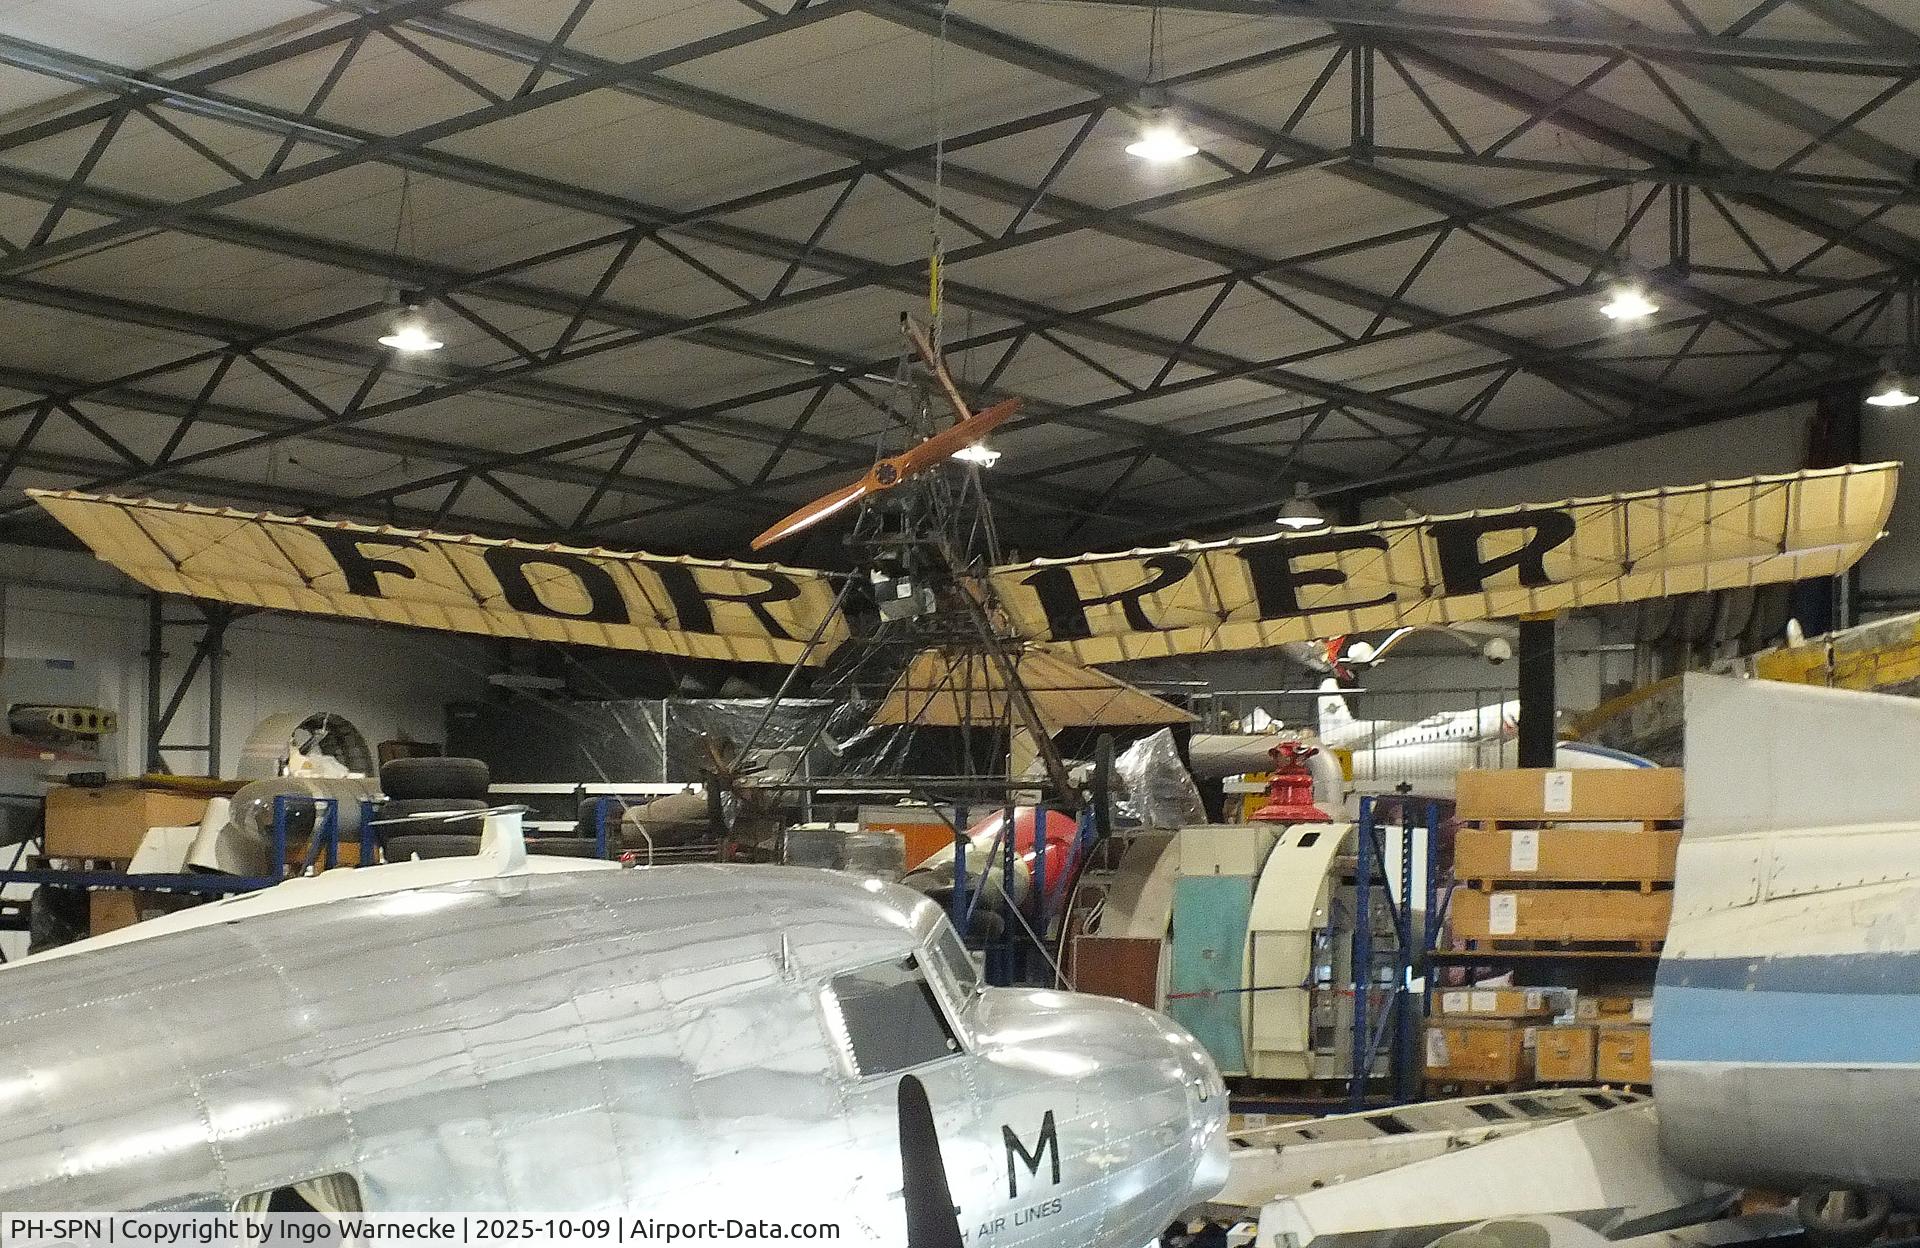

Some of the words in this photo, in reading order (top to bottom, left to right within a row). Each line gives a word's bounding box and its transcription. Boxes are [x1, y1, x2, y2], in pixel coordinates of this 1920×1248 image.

[1001, 1109, 1061, 1199] M
[978, 1217, 1006, 1239] AIR
[1014, 1198, 1063, 1227] LINES
